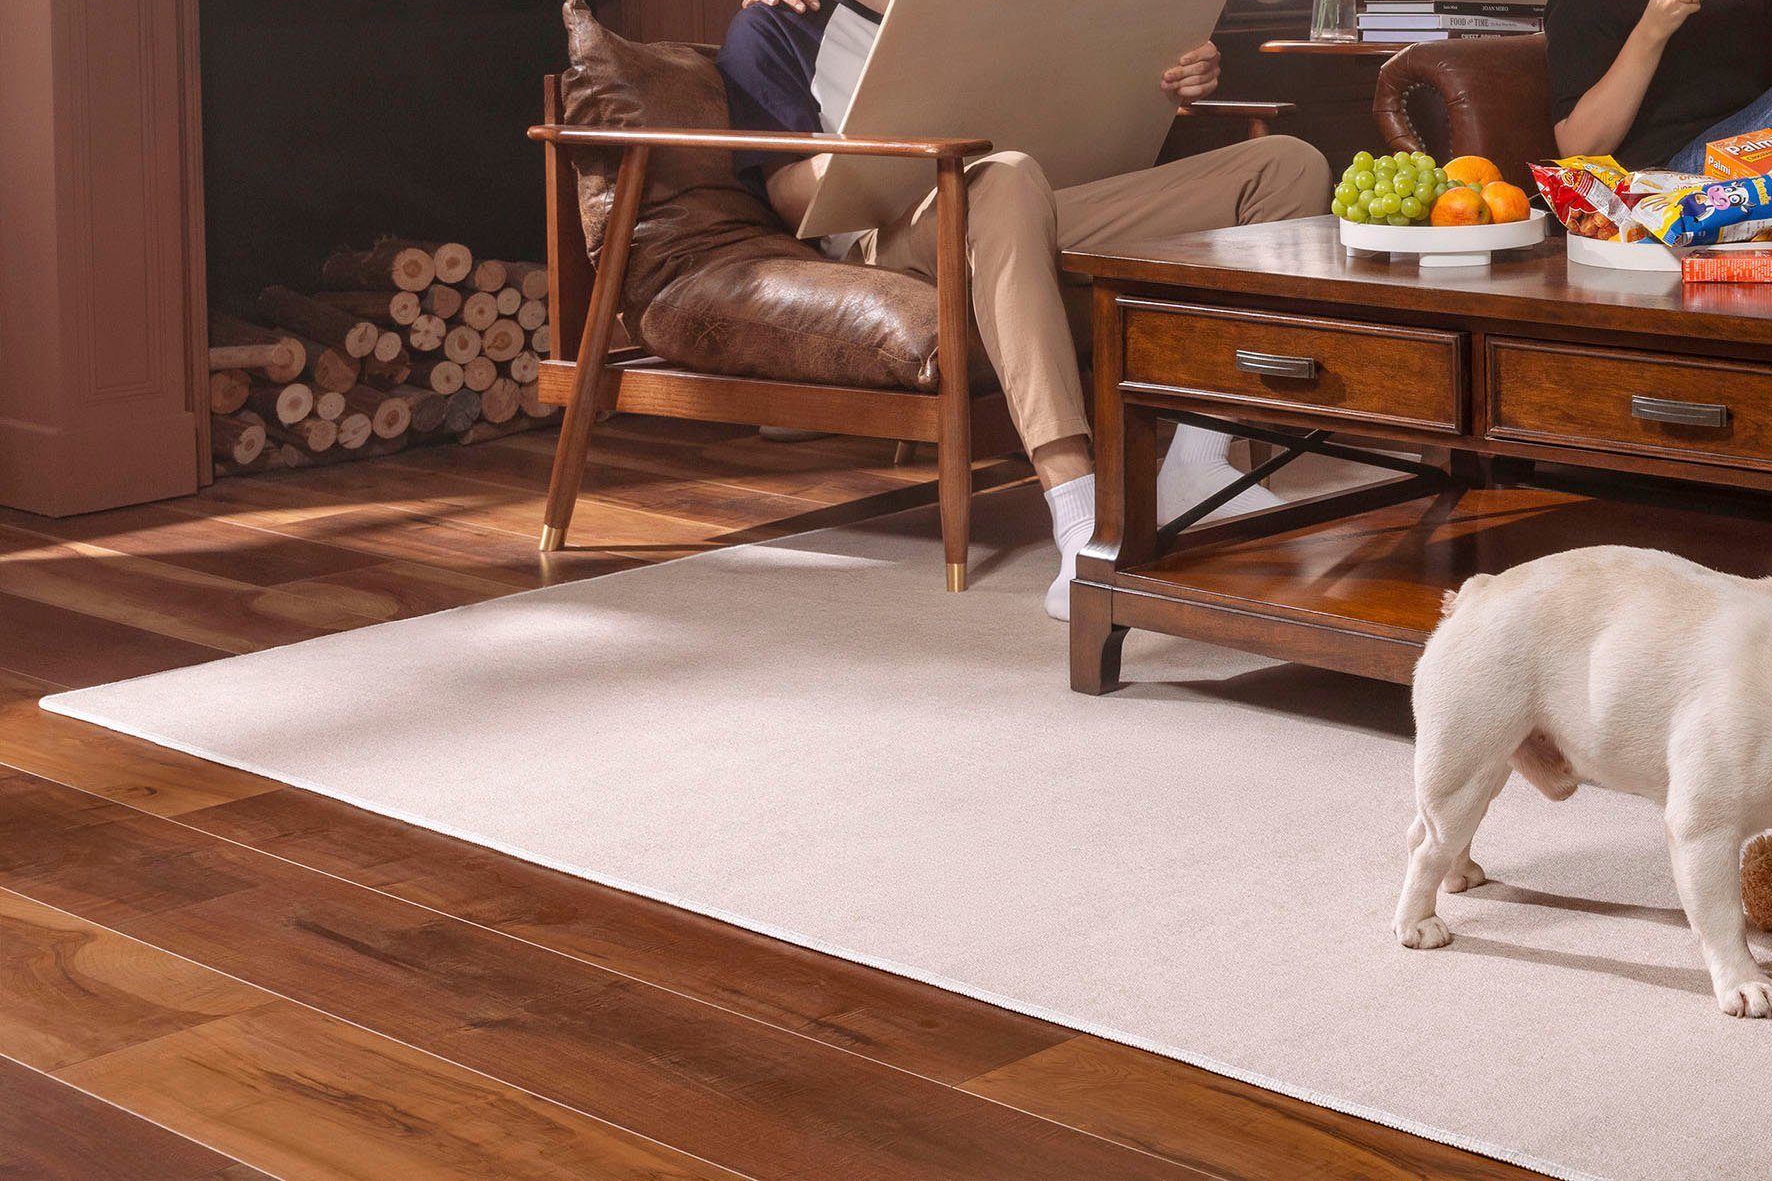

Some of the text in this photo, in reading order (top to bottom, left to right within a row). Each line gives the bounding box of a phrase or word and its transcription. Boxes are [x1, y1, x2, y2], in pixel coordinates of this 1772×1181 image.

[1450, 18, 1466, 26] FOOD
[1475, 19, 1489, 27] TIME
[1708, 156, 1731, 175] Palmi
